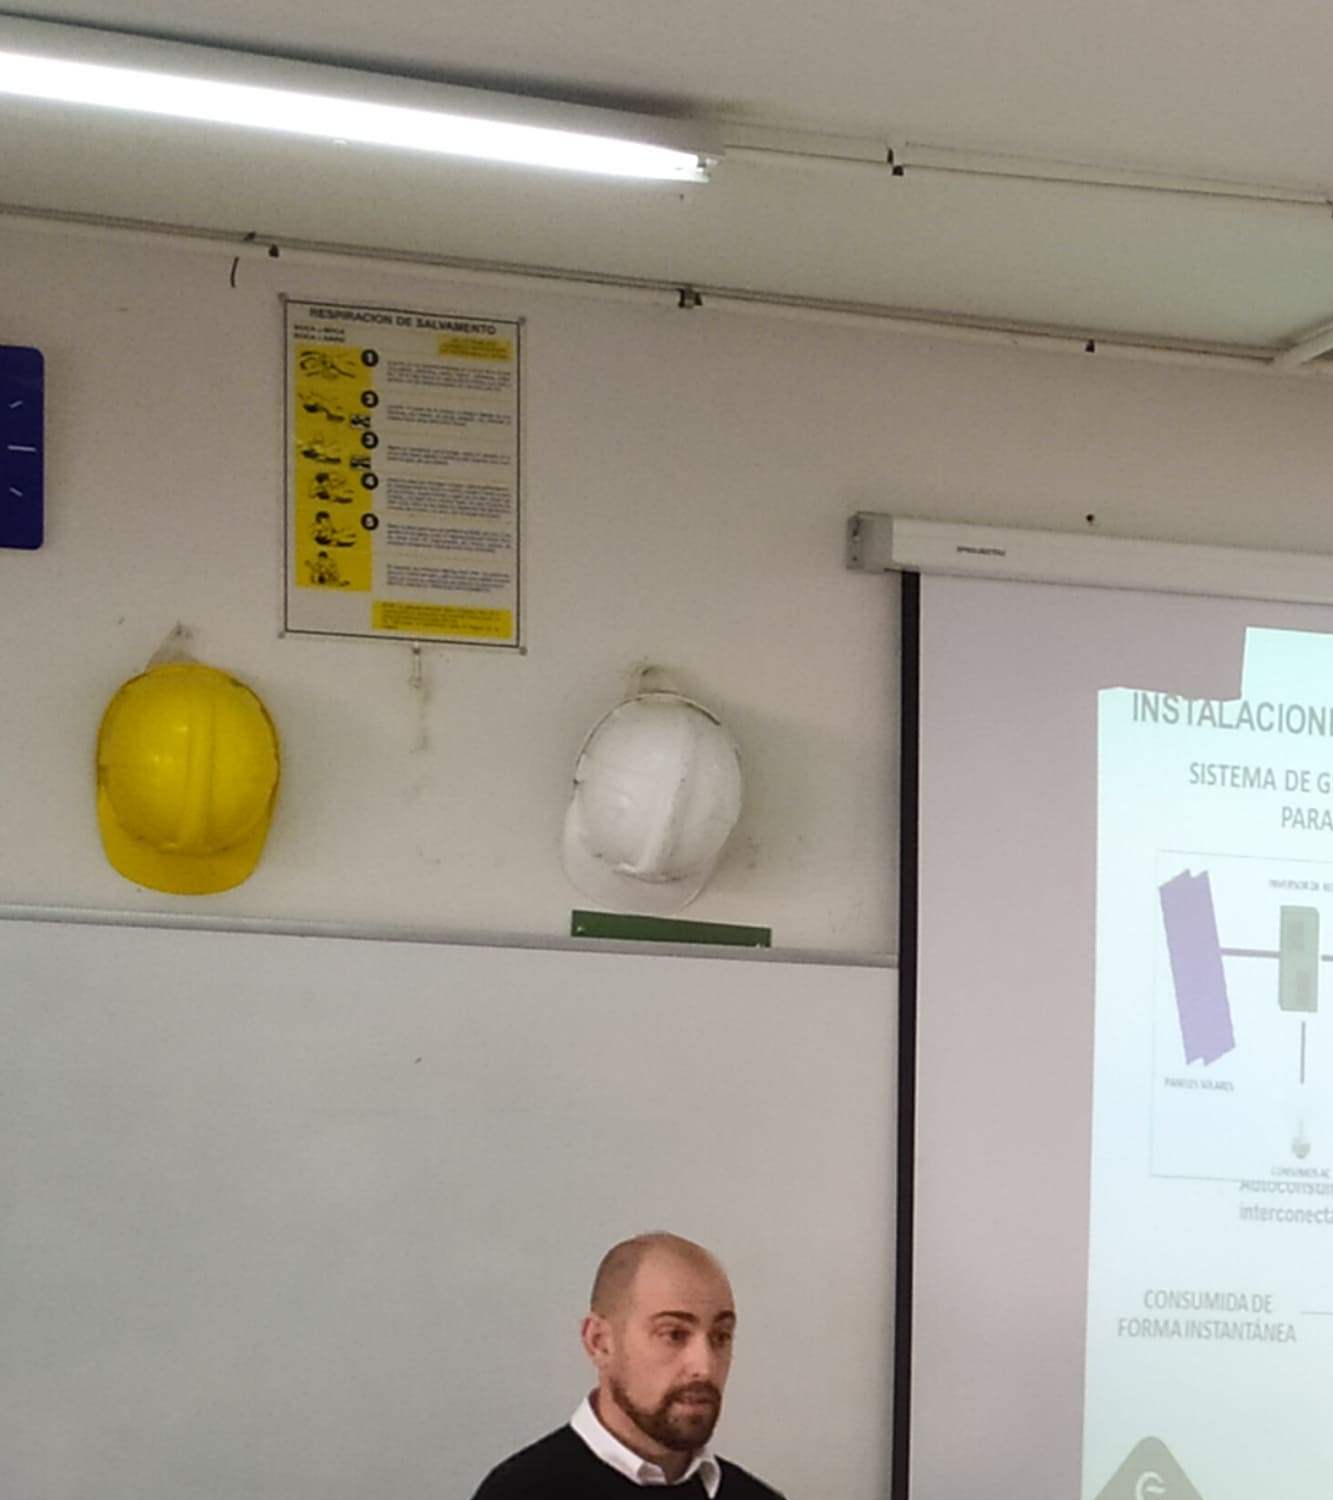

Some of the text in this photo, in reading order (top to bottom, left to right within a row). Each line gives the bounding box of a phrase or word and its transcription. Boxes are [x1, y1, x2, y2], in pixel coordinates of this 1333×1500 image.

[1189, 762, 1277, 791] SISTEMA
[1285, 770, 1310, 793] DE
[1281, 806, 1333, 833] PARA
[1143, 1289, 1273, 1313] CONSUMIDA DE
[1118, 1317, 1296, 1343] FORMA INSTANTÁNEA
